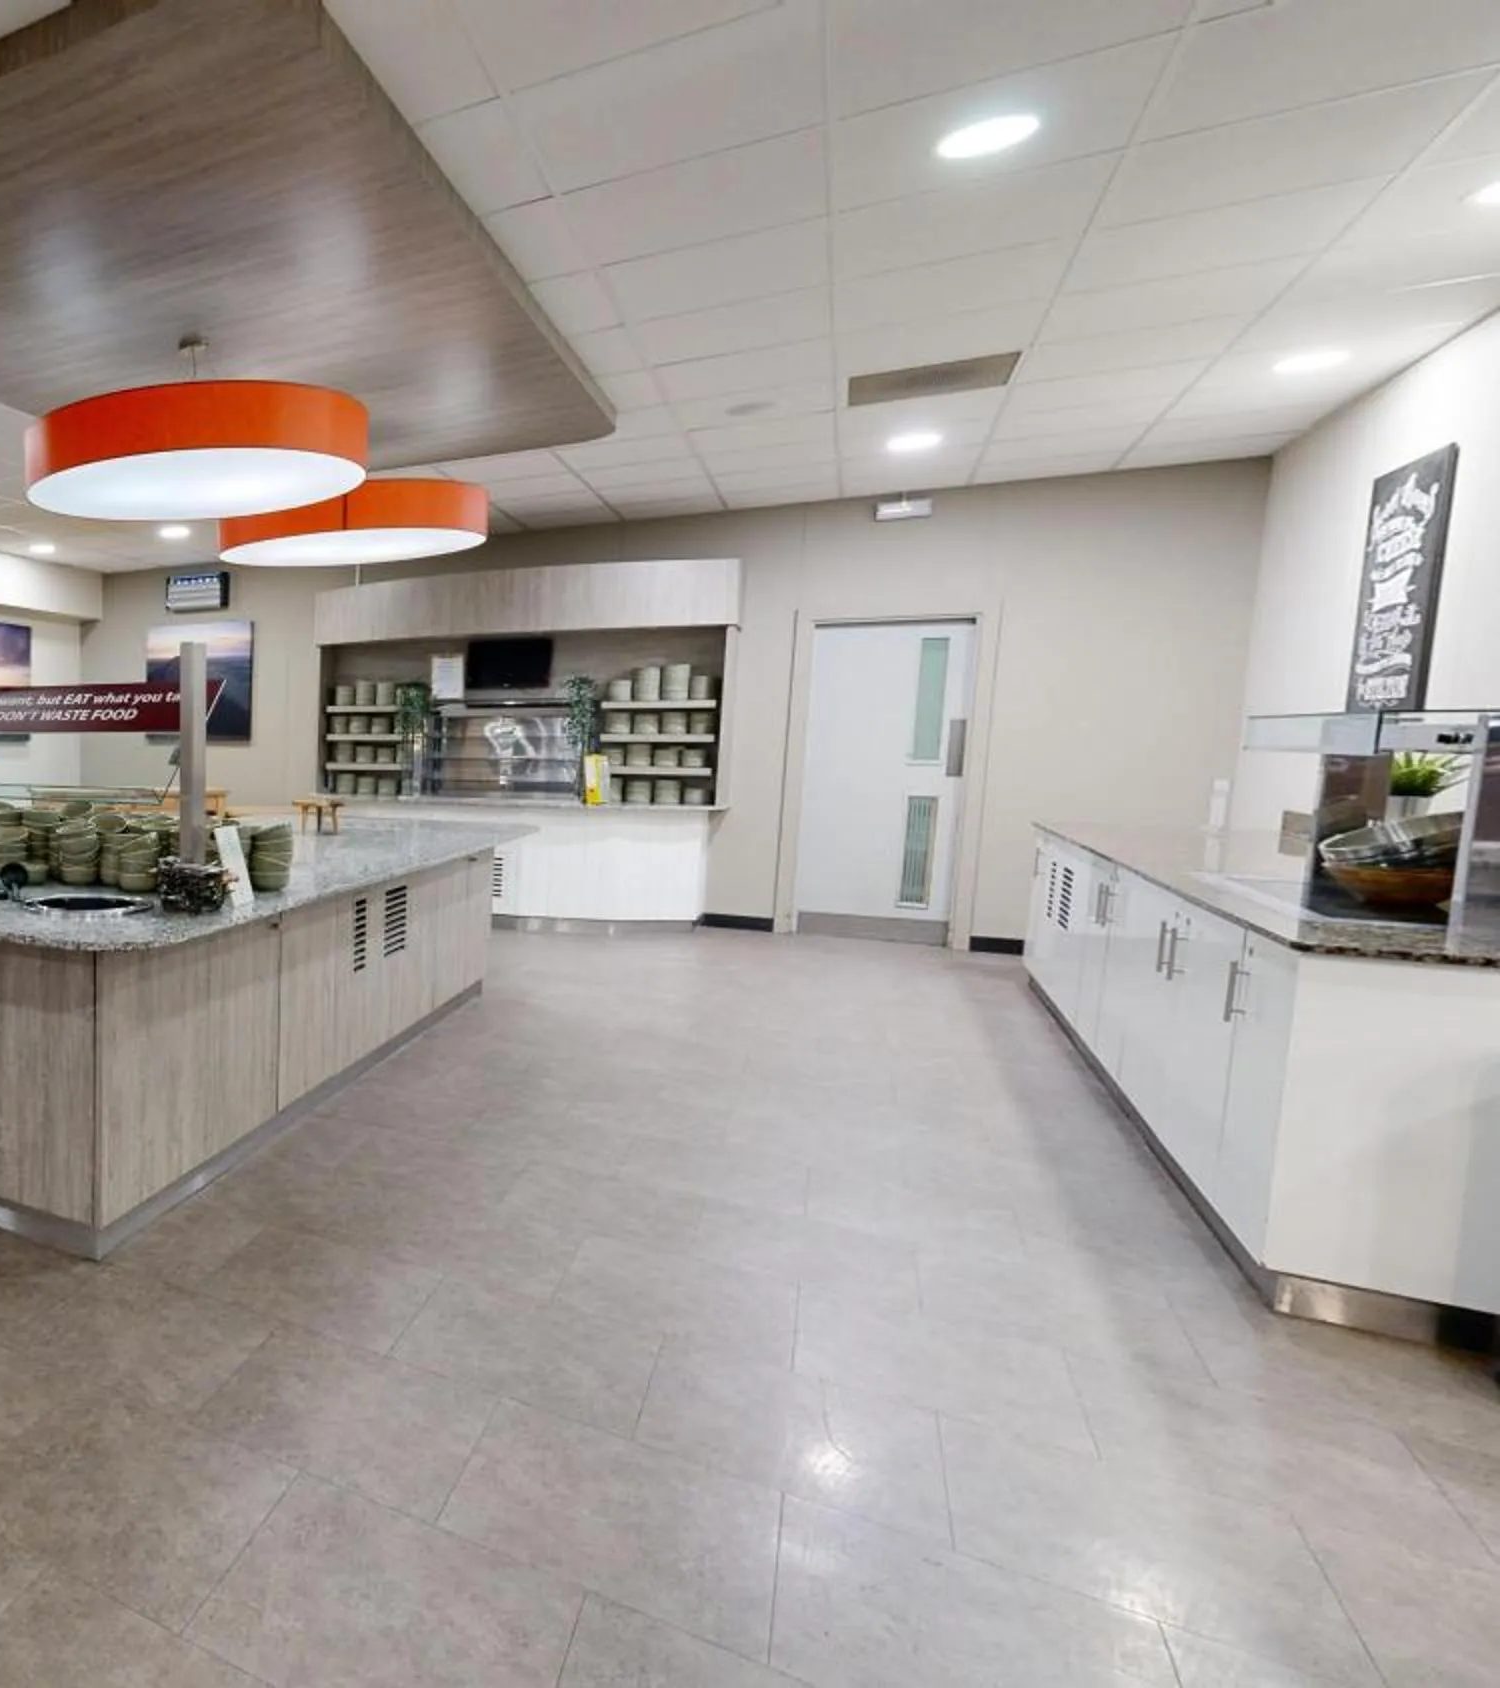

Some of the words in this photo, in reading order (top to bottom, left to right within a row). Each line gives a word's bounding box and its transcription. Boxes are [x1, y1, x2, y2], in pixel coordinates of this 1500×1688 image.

[37, 693, 61, 705] but
[63, 692, 93, 704] EAT
[93, 691, 130, 704] what
[131, 692, 163, 705] you
[165, 691, 181, 703] ta
[40, 709, 90, 721] WASTE
[91, 708, 138, 721] FOOD
